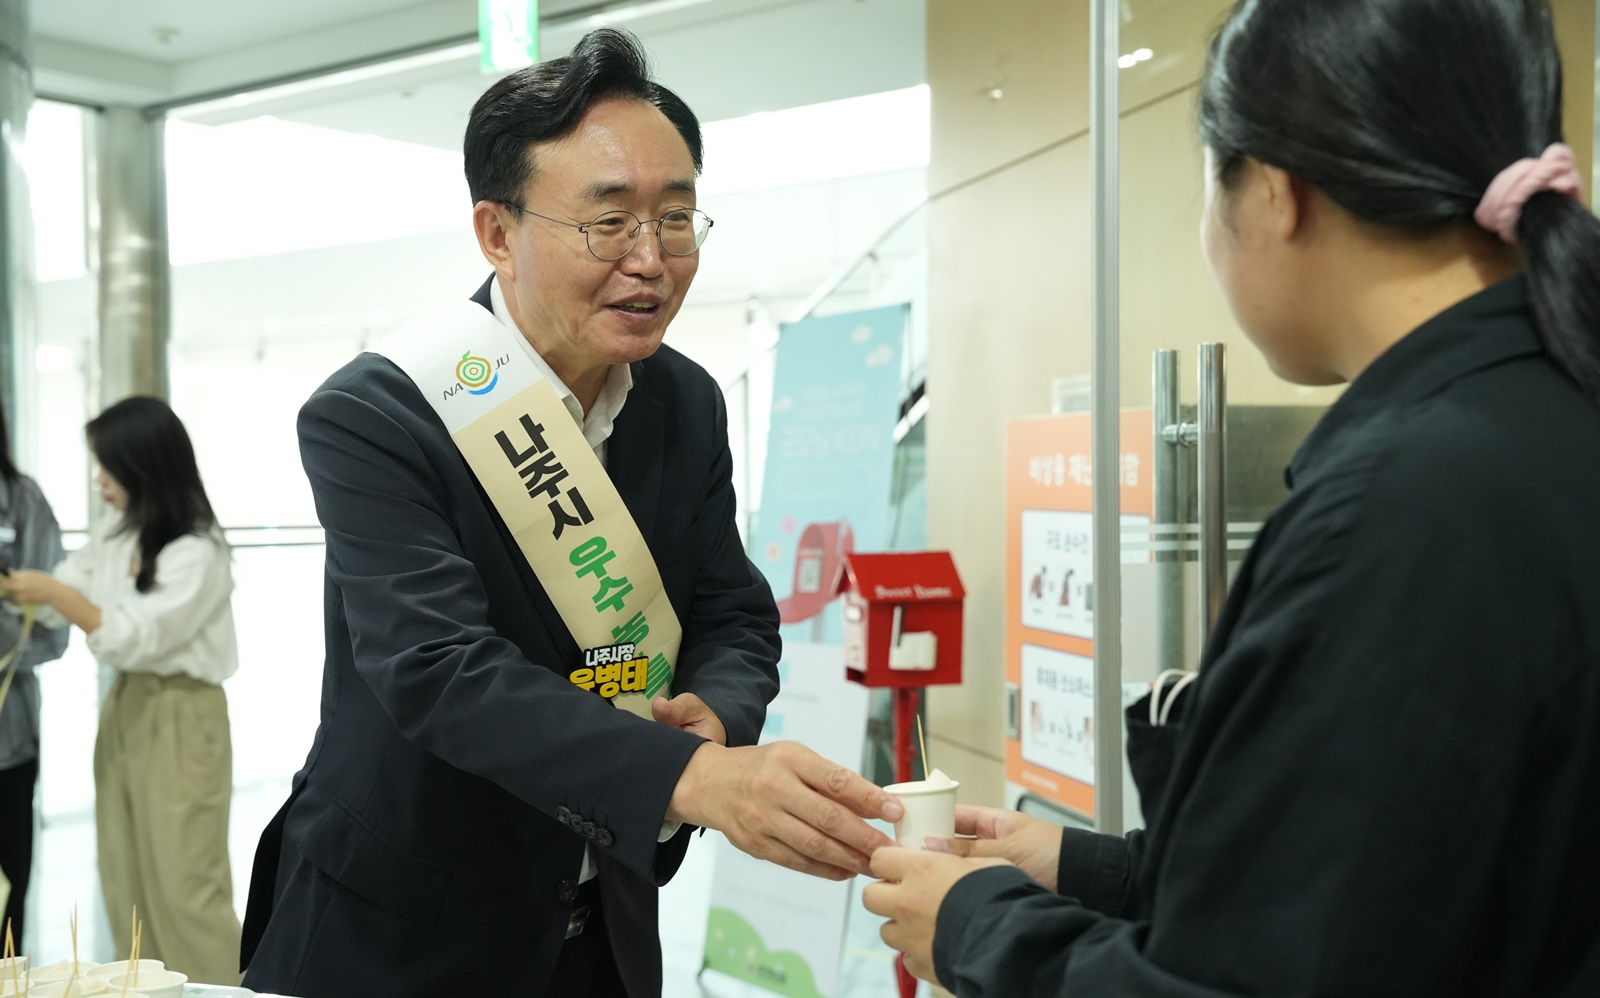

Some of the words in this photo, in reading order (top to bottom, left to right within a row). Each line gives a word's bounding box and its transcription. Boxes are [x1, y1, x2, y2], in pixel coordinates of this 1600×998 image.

[494, 413, 595, 540] 나주시
[568, 535, 634, 613] 우수
[585, 644, 635, 667] 나주시장
